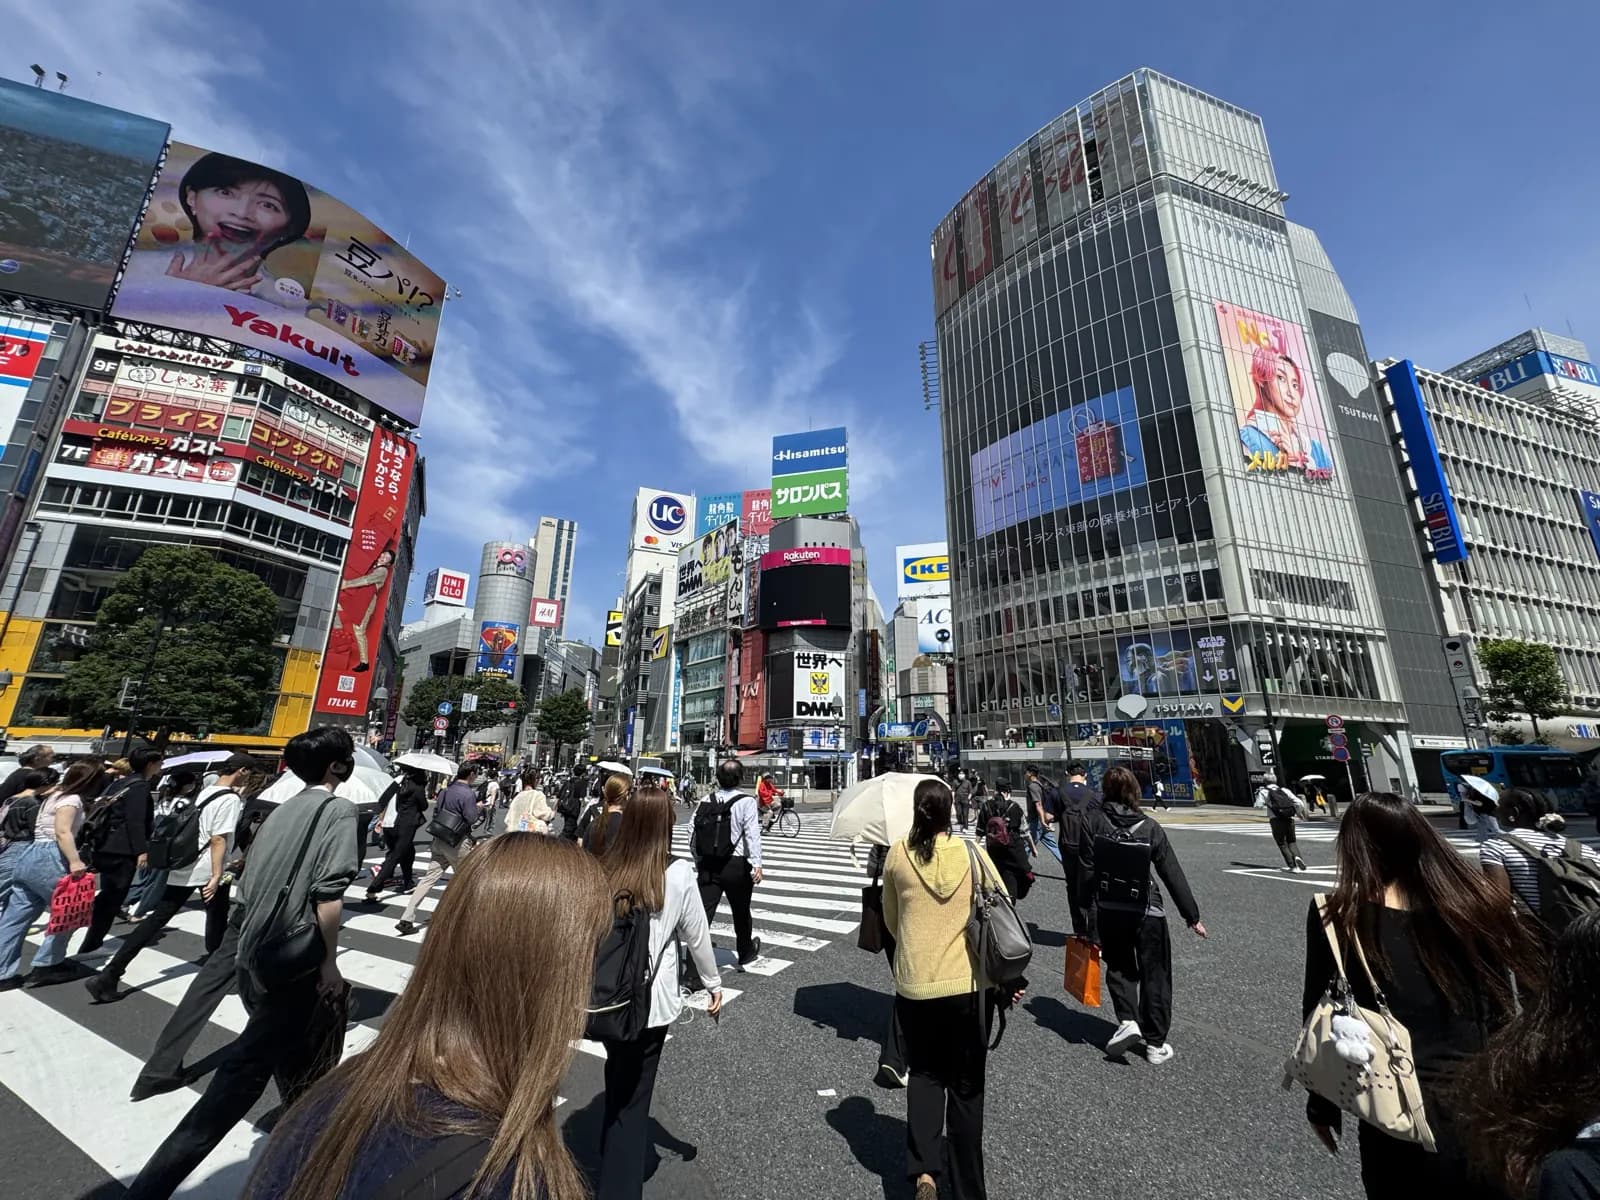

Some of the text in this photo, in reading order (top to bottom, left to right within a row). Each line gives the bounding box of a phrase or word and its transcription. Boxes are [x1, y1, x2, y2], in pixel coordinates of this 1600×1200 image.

[223, 304, 361, 377] Yakult
[94, 360, 118, 373] 9F
[160, 368, 228, 393] しゃぶ葉
[110, 399, 220, 431] プライス
[1338, 405, 1380, 423] TSUTAYA
[61, 445, 91, 460] 7F
[169, 436, 225, 456] ガスト
[251, 423, 340, 471] コンタクト
[774, 445, 845, 461] Hisamitsu
[128, 452, 200, 479] ガスト
[310, 475, 350, 498] ガスト
[775, 482, 842, 505] サロンパス
[652, 502, 683, 524] UC
[1422, 492, 1457, 552] SEIBU
[783, 551, 821, 562] Rakuten
[443, 575, 461, 587] UNI
[678, 574, 703, 597] DMM
[442, 586, 461, 598] QLO
[796, 652, 843, 670] 世界へ
[1218, 668, 1236, 681] B1
[980, 690, 1088, 712] STARBUCKS
[1156, 701, 1215, 713] TSUTAYA
